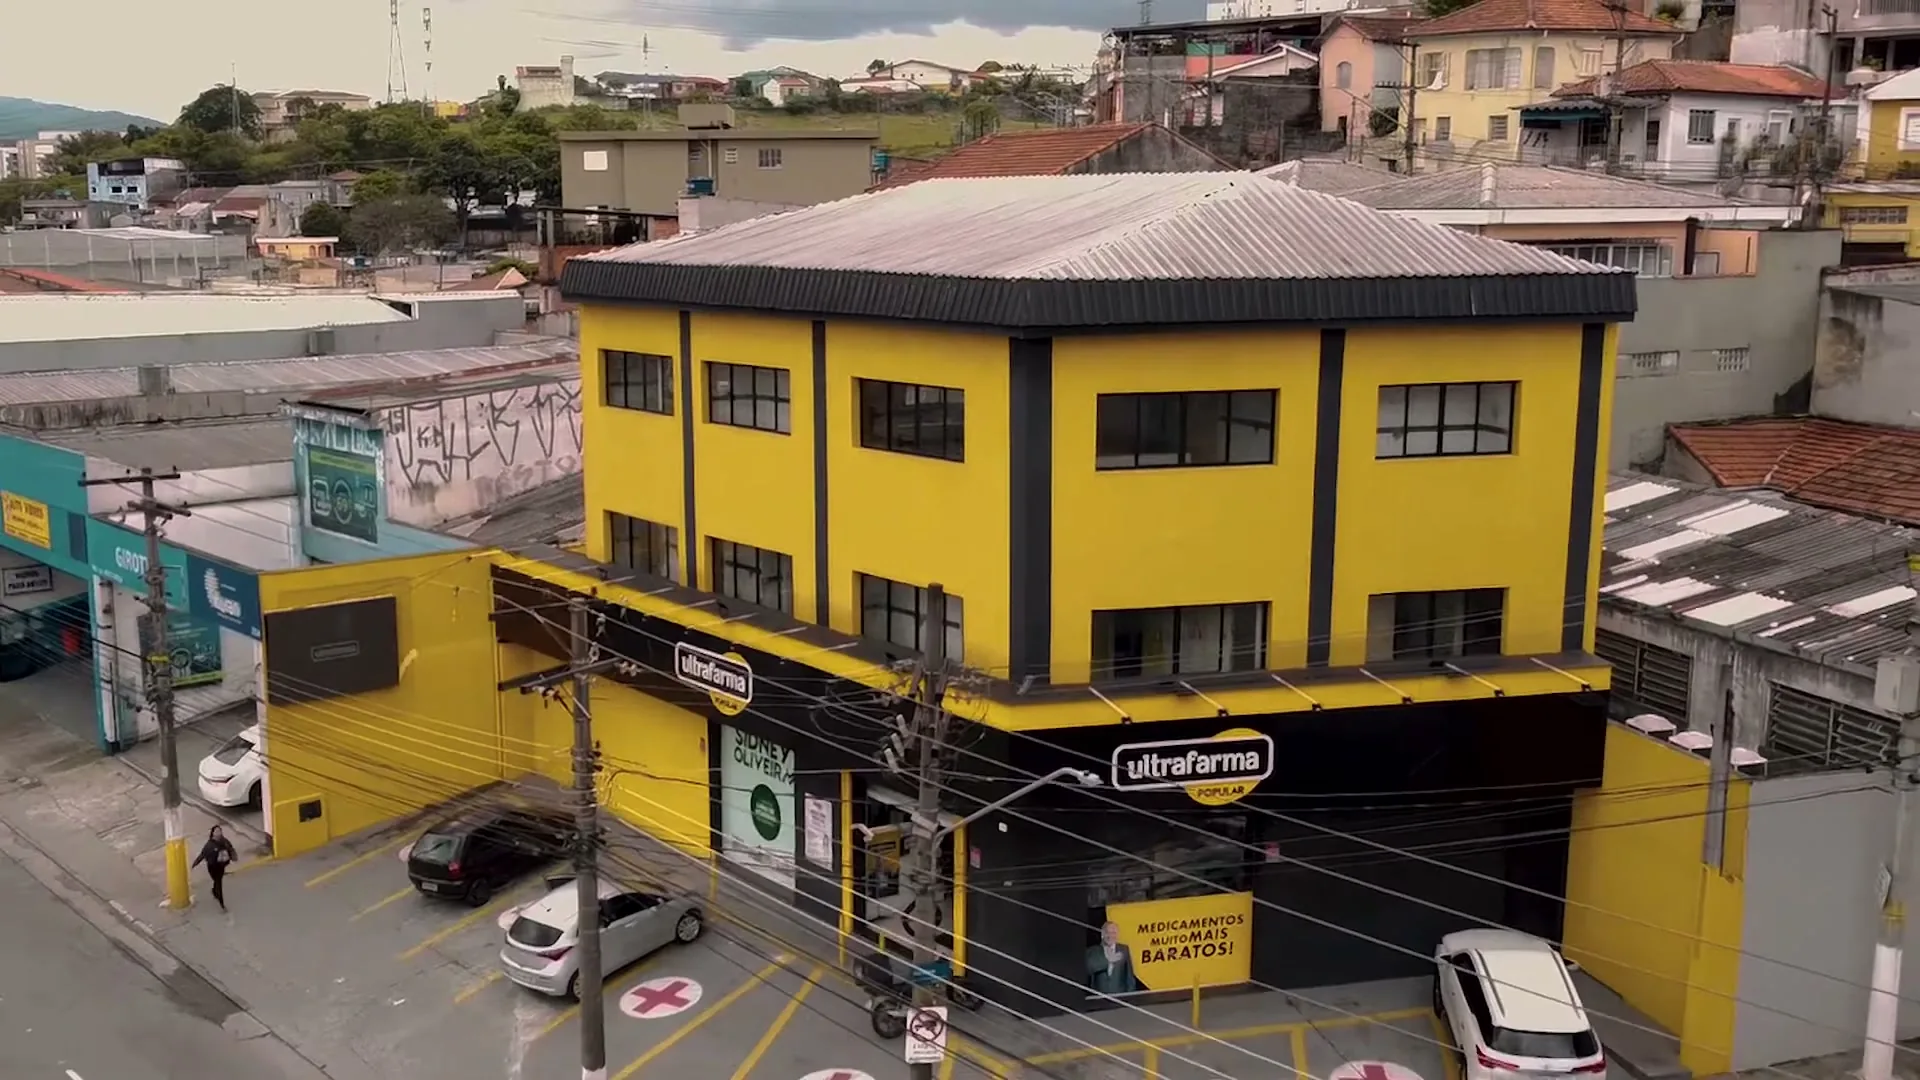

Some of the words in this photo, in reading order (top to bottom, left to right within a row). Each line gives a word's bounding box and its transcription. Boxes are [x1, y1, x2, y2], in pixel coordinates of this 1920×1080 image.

[681, 654, 746, 693] ultrafarma
[735, 727, 789, 764] SIDNEY
[1127, 751, 1260, 779] ultrafarma
[1198, 786, 1245, 797] POPULAR
[1137, 913, 1244, 934] MEDICAMENTOS
[1141, 941, 1233, 964] BARATOS!
